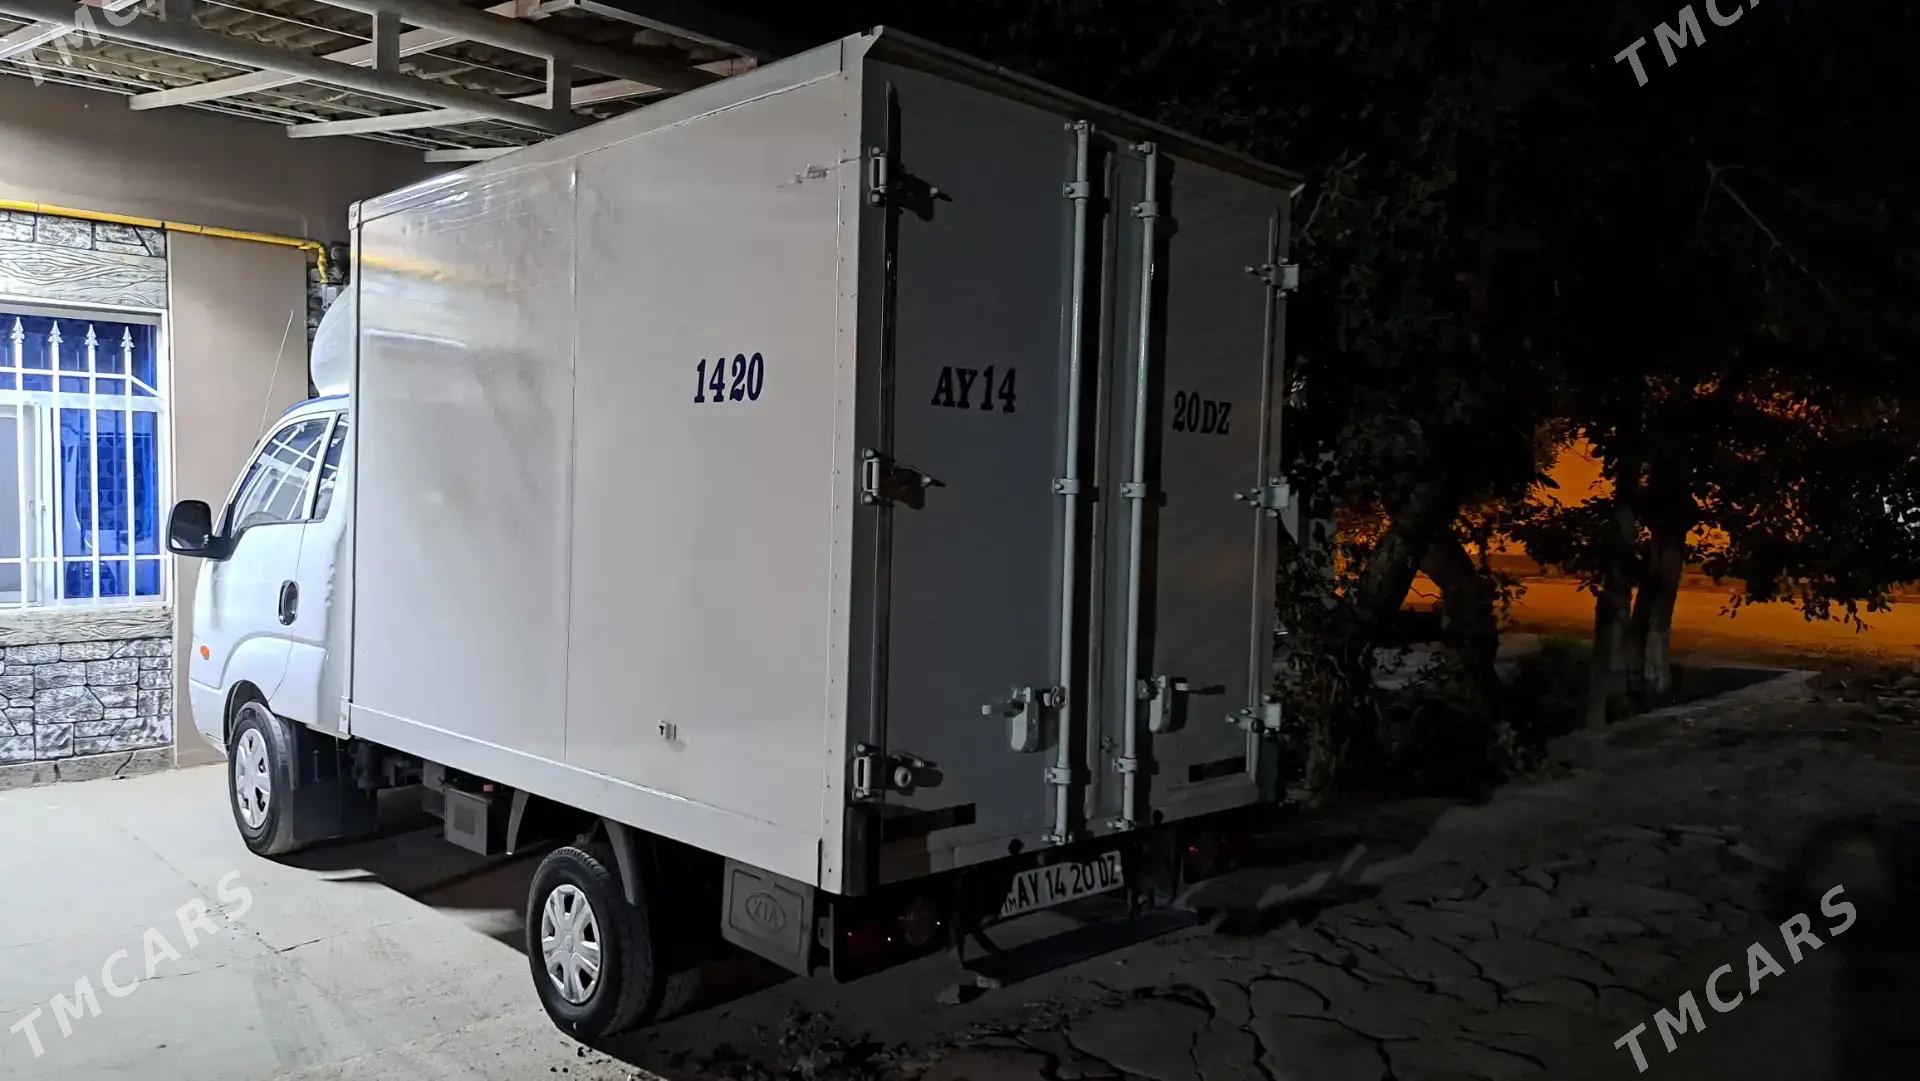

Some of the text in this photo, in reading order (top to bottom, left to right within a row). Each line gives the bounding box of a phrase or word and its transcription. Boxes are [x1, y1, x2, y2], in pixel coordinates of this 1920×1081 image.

[1017, 872, 1040, 908] AY
[1045, 867, 1067, 900] 14
[1070, 863, 1096, 895] 20
[1098, 854, 1120, 888] DZ
